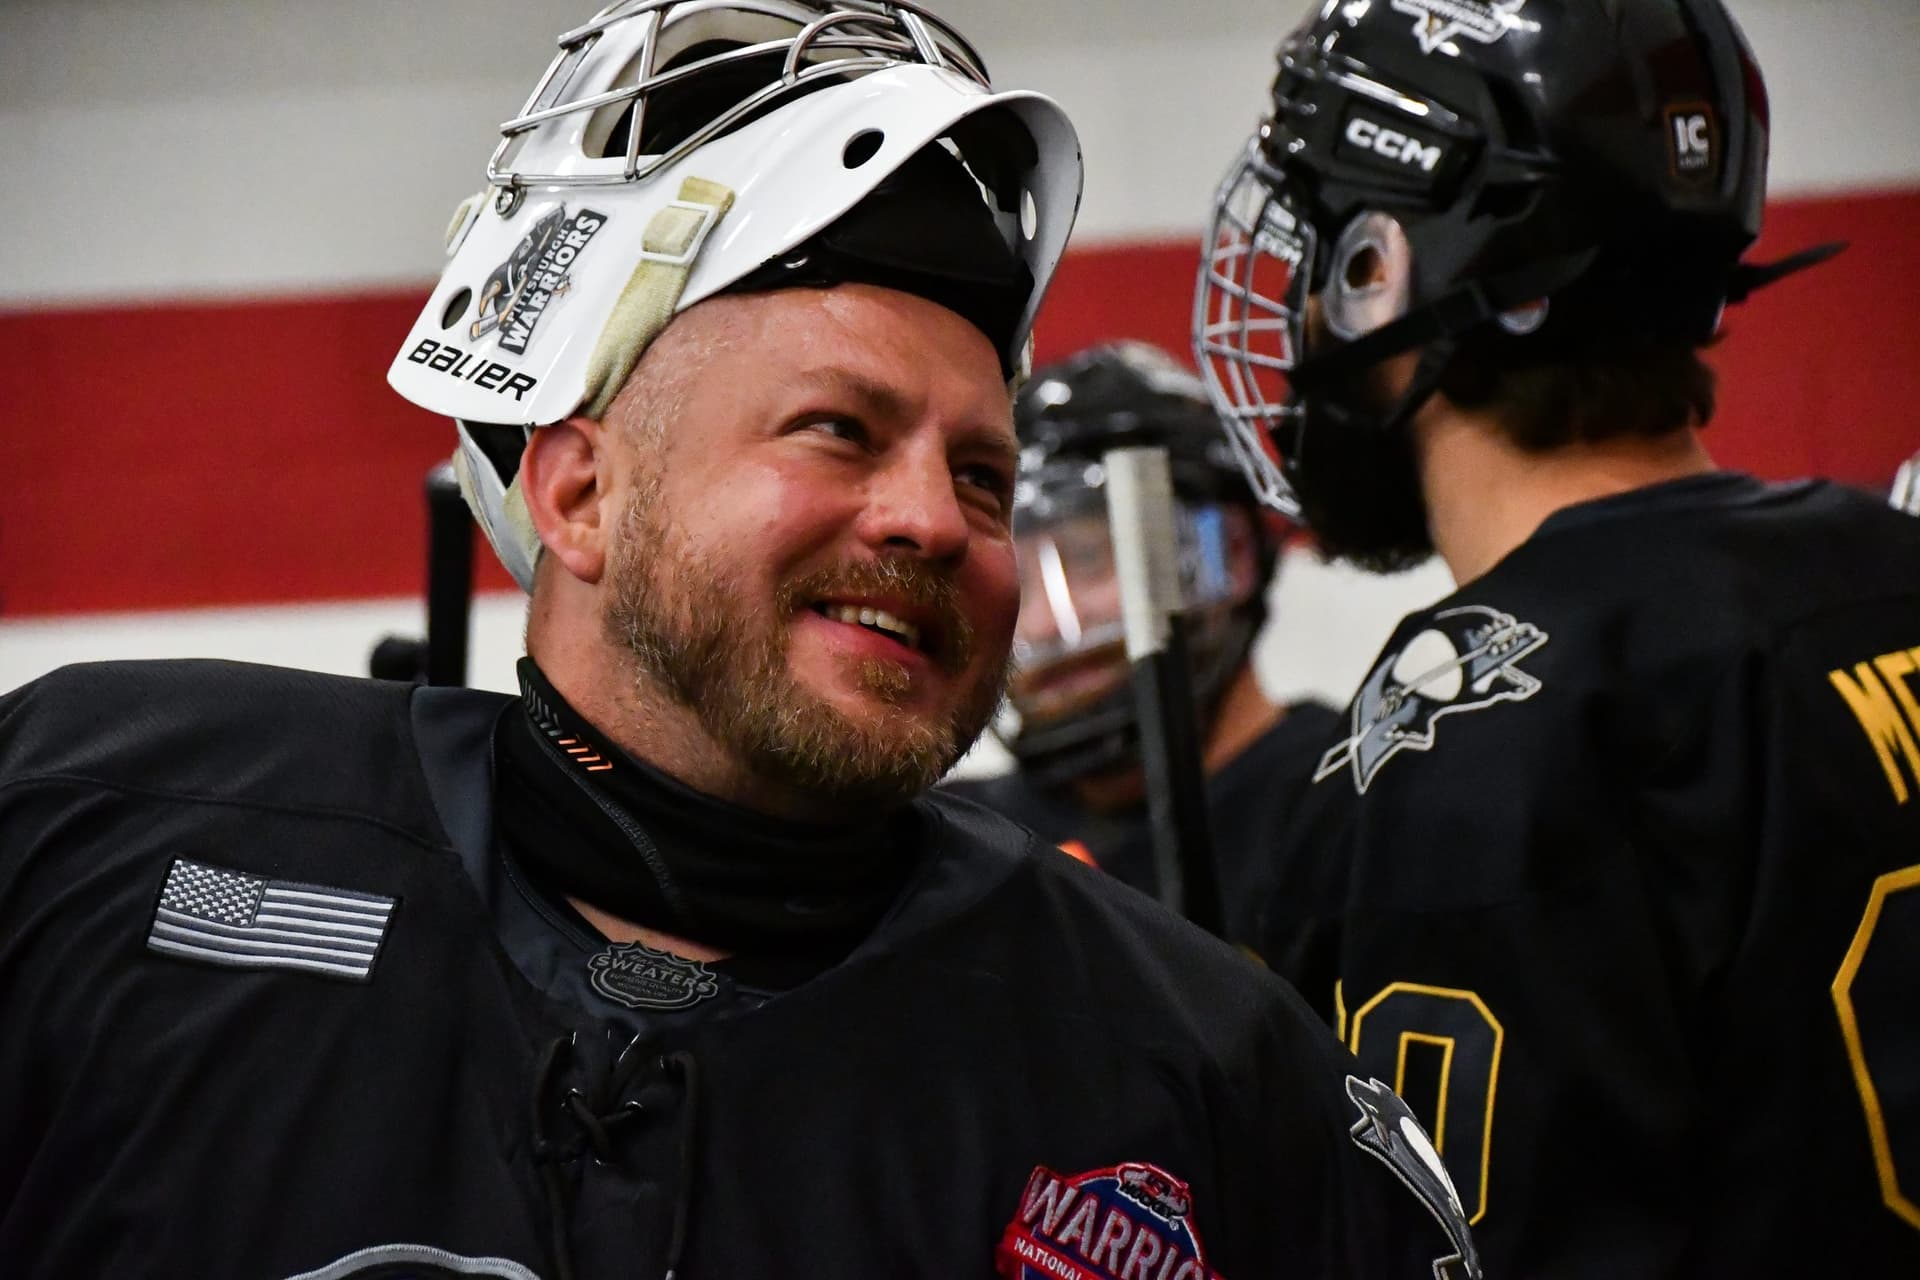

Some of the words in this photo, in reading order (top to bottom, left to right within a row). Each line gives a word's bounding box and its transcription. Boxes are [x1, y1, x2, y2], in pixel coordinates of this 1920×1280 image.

[1346, 118, 1441, 171] CCM
[1675, 115, 1709, 153] IC
[502, 215, 601, 348] WARRIORS
[505, 228, 569, 323] PITTSBURGH
[408, 338, 538, 402] BAUER
[596, 956, 710, 993] SWEATERS
